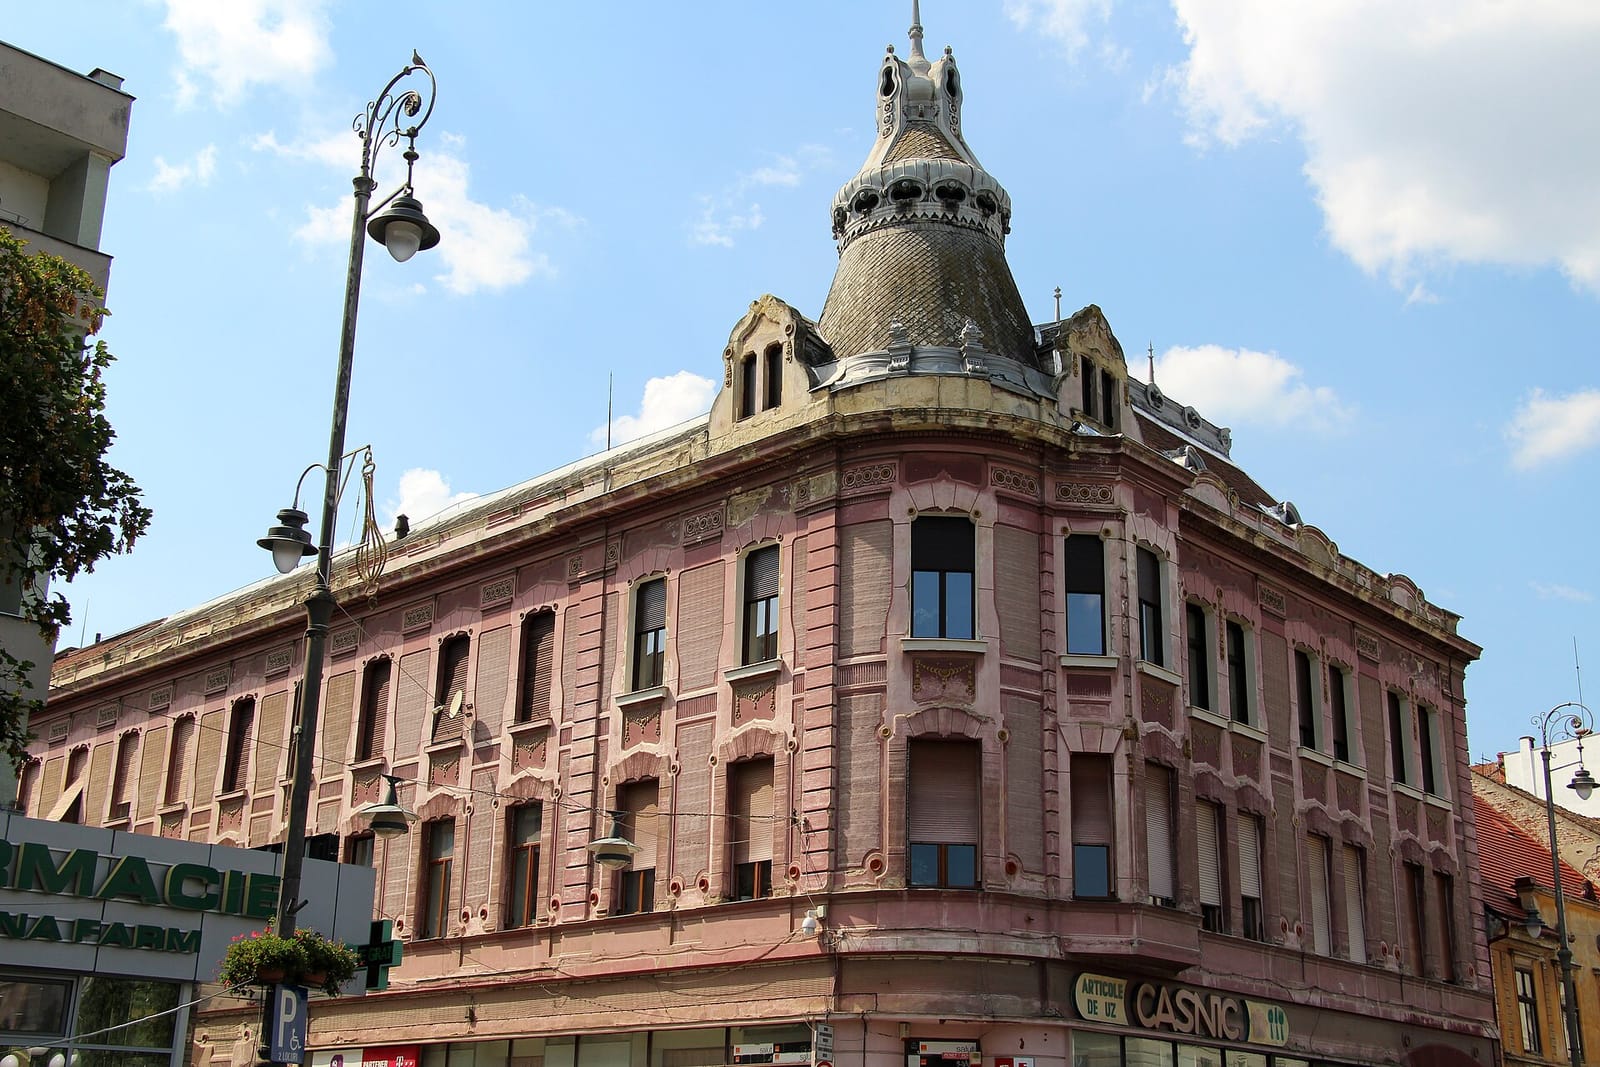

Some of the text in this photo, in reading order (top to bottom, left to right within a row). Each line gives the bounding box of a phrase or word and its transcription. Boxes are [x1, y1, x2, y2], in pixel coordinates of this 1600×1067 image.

[0, 838, 281, 919] MACIE
[73, 918, 201, 954] FARM
[1082, 978, 1123, 999] ARTICOLE
[1087, 999, 1117, 1018] DE UZ
[1137, 983, 1239, 1040] CASNIC
[278, 989, 297, 1048] P
